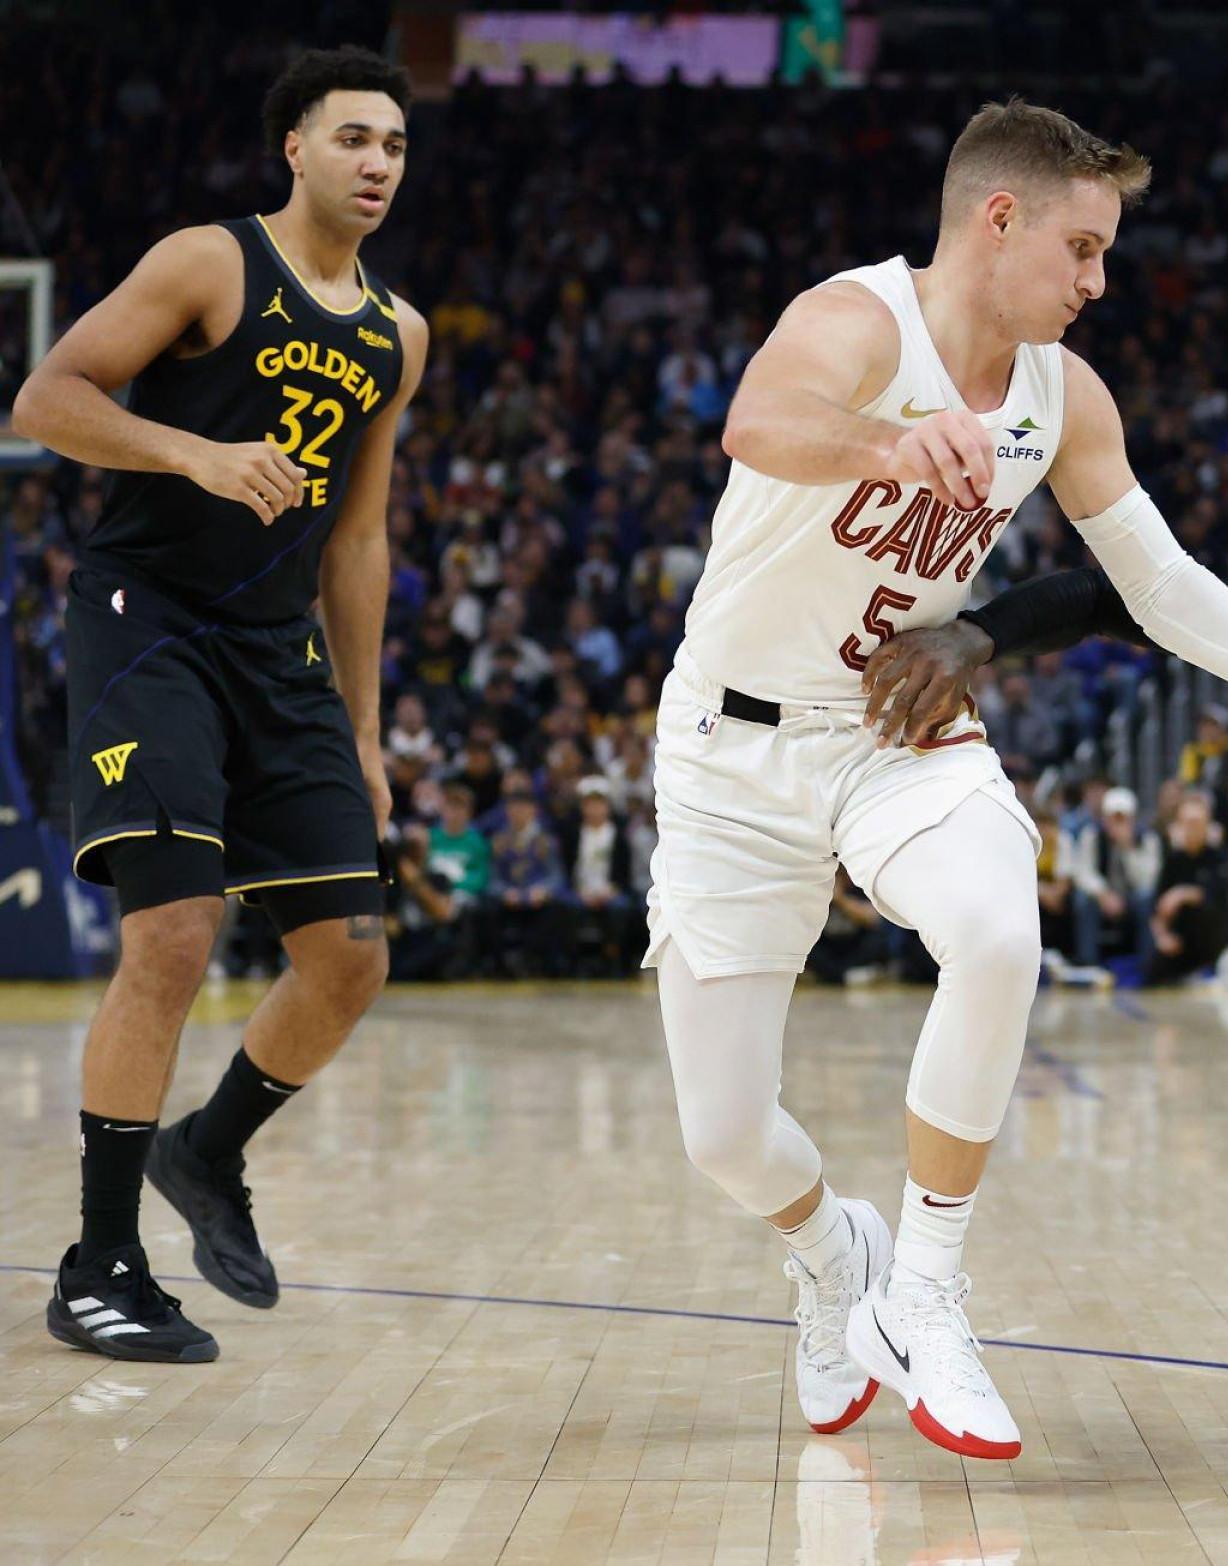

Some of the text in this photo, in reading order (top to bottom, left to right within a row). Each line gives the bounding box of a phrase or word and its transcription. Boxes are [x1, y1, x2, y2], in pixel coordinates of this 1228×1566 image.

[256, 341, 381, 413] GOLDEN
[265, 385, 344, 468] 32
[997, 446, 1044, 461] CLIFFS
[831, 479, 1012, 583] CAVS
[839, 584, 917, 673] 5
